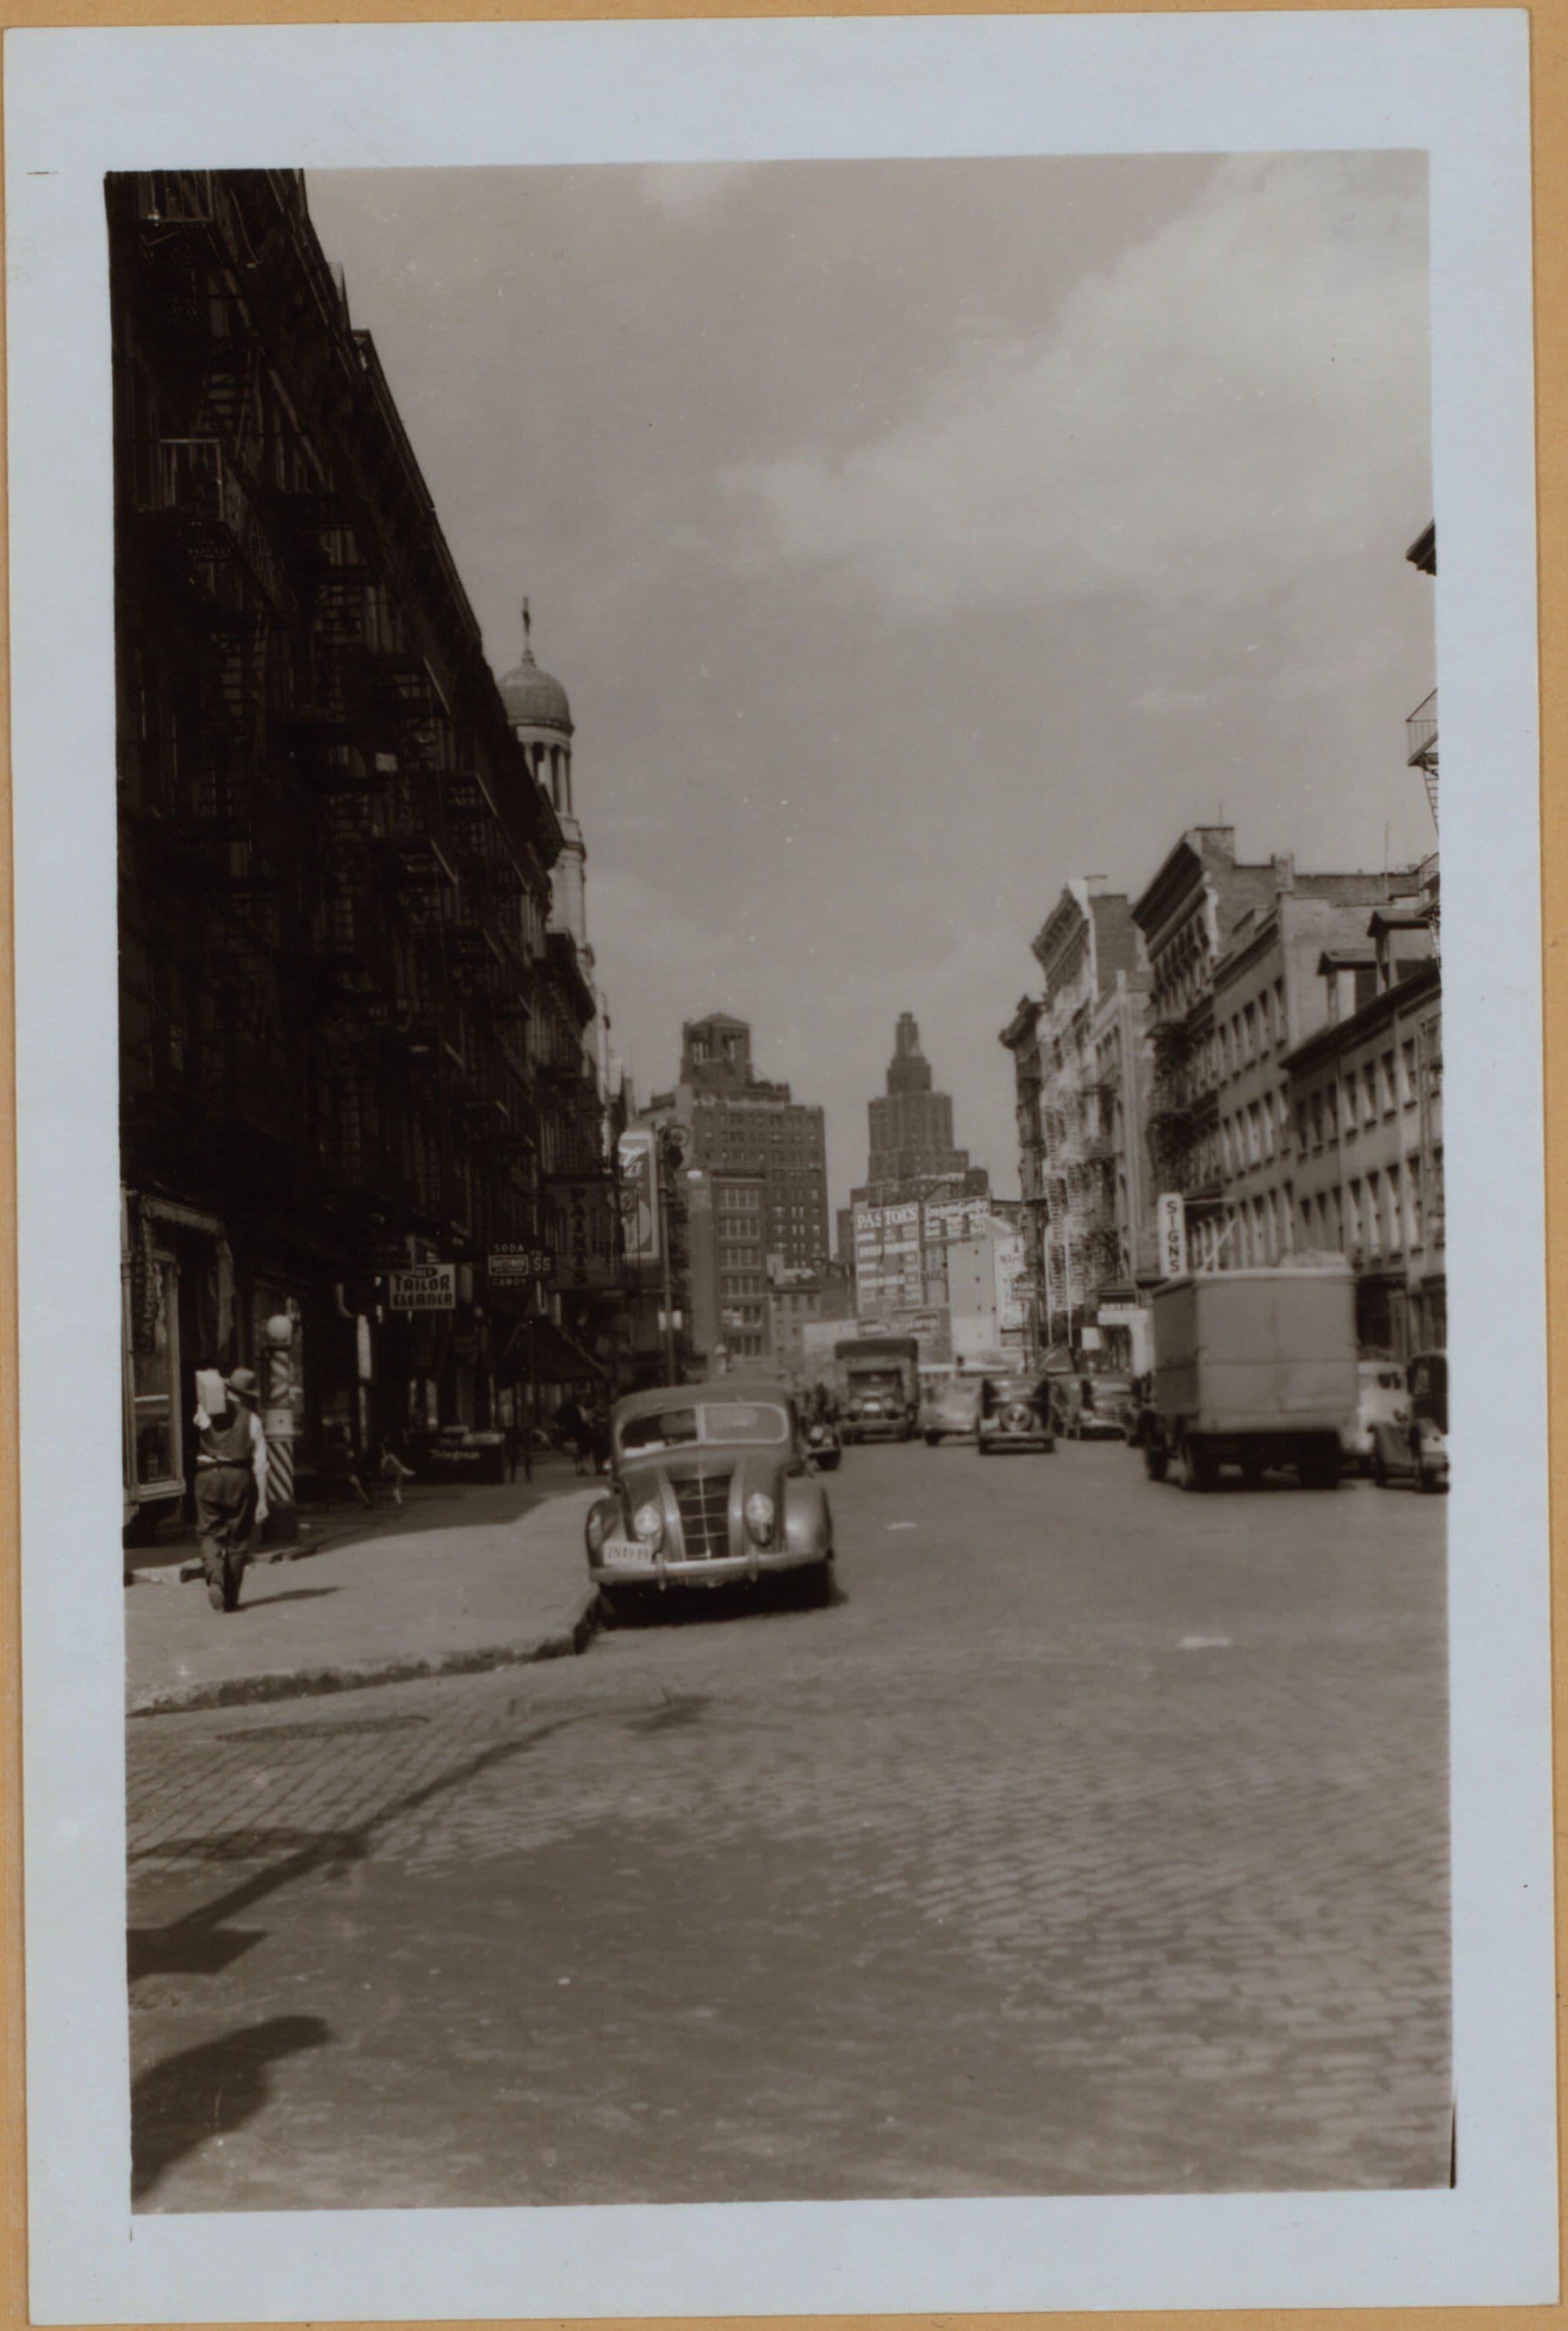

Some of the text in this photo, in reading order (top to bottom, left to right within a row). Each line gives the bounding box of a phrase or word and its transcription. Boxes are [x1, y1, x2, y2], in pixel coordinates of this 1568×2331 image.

[1166, 1201, 1180, 1272] SIGNS
[494, 1244, 523, 1253] SODA
[395, 1274, 450, 1292] TAILOR
[492, 1278, 527, 1286] CANDY
[394, 1292, 453, 1306] CLEANER
